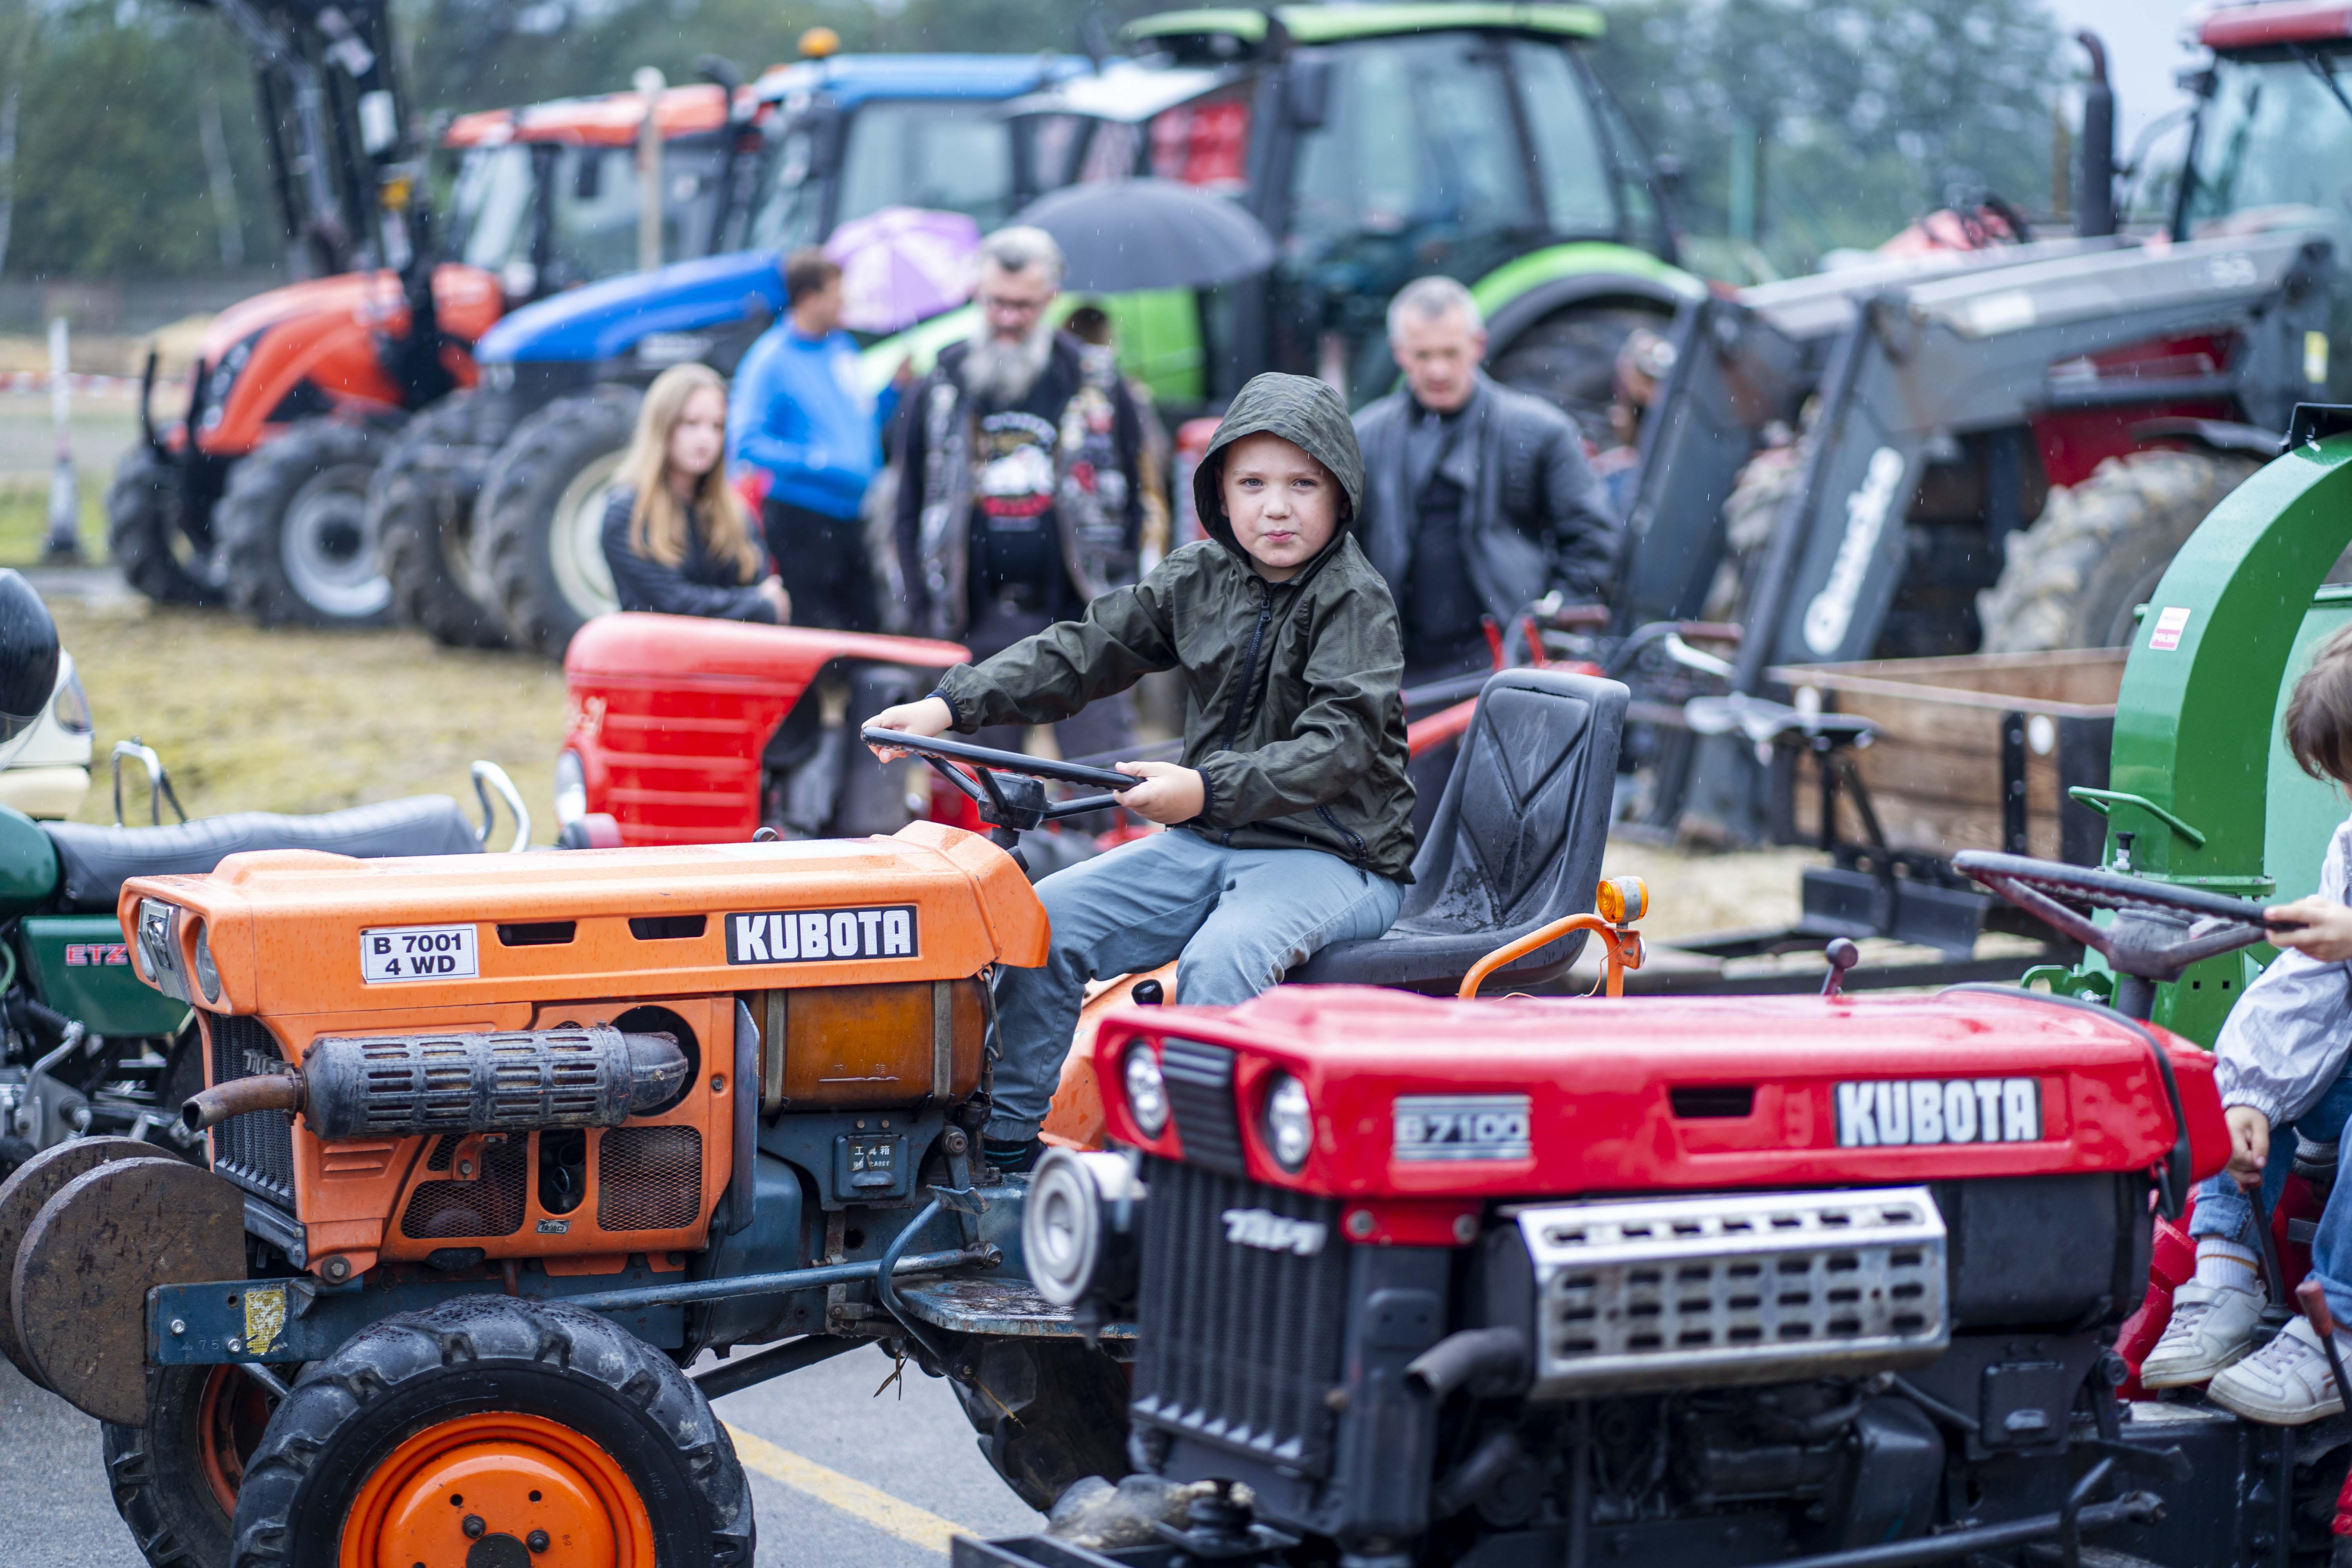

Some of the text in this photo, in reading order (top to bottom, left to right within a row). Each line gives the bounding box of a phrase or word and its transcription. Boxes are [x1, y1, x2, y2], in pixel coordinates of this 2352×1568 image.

[374, 933, 461, 955] B 7001
[736, 910, 911, 961] KUBOTA
[66, 943, 128, 966] ETZ
[385, 955, 456, 975] 4 WD
[1838, 1078, 2038, 1147] KUBOTA
[1396, 1113, 1530, 1142] B7100
